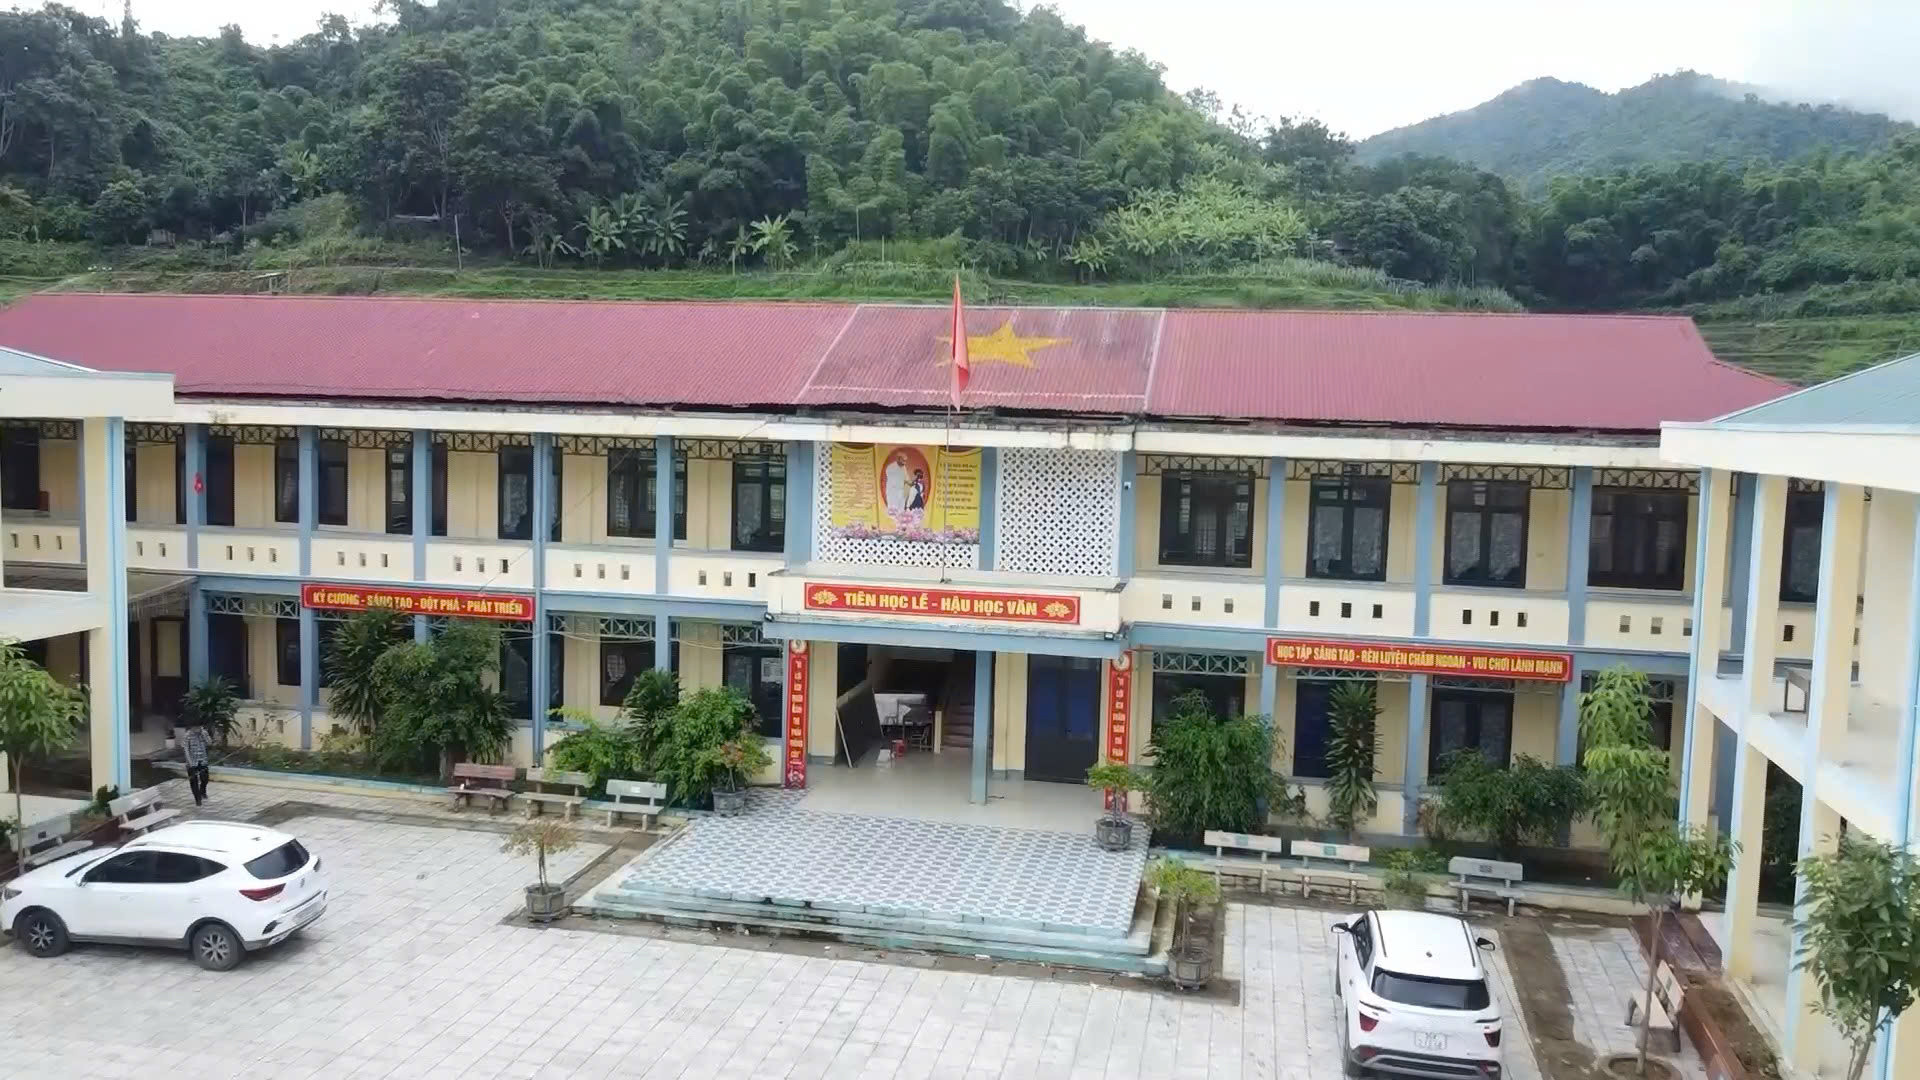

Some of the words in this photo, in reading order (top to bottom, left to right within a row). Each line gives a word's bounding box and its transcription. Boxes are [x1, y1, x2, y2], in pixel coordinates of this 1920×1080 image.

[367, 592, 393, 609] SÁNG
[394, 596, 413, 611] TẠO
[420, 596, 439, 612] ĐỘT
[440, 597, 460, 611] PHÁ
[466, 598, 492, 613] PHÁT
[844, 590, 877, 607] TIÊN
[879, 594, 909, 611] HỌC
[911, 592, 929, 610] LỄ
[941, 595, 971, 614] HẬU
[973, 599, 1004, 616] HỌC
[1007, 599, 1038, 616] VĂN
[1277, 644, 1295, 662] HỌC
[1296, 643, 1313, 662] TẬP
[1313, 644, 1338, 661] SÁNG
[1339, 648, 1356, 664] TẠO
[1361, 647, 1380, 664] RÈN
[1380, 650, 1407, 668] LUYỆN
[1409, 651, 1434, 667] CHĂM
[1435, 653, 1466, 669] NGOAN
[1473, 656, 1487, 670] VUI
[1489, 656, 1510, 671] CHƠI
[1511, 655, 1534, 672] LÀNH
[1536, 659, 1563, 676] MẠNH
